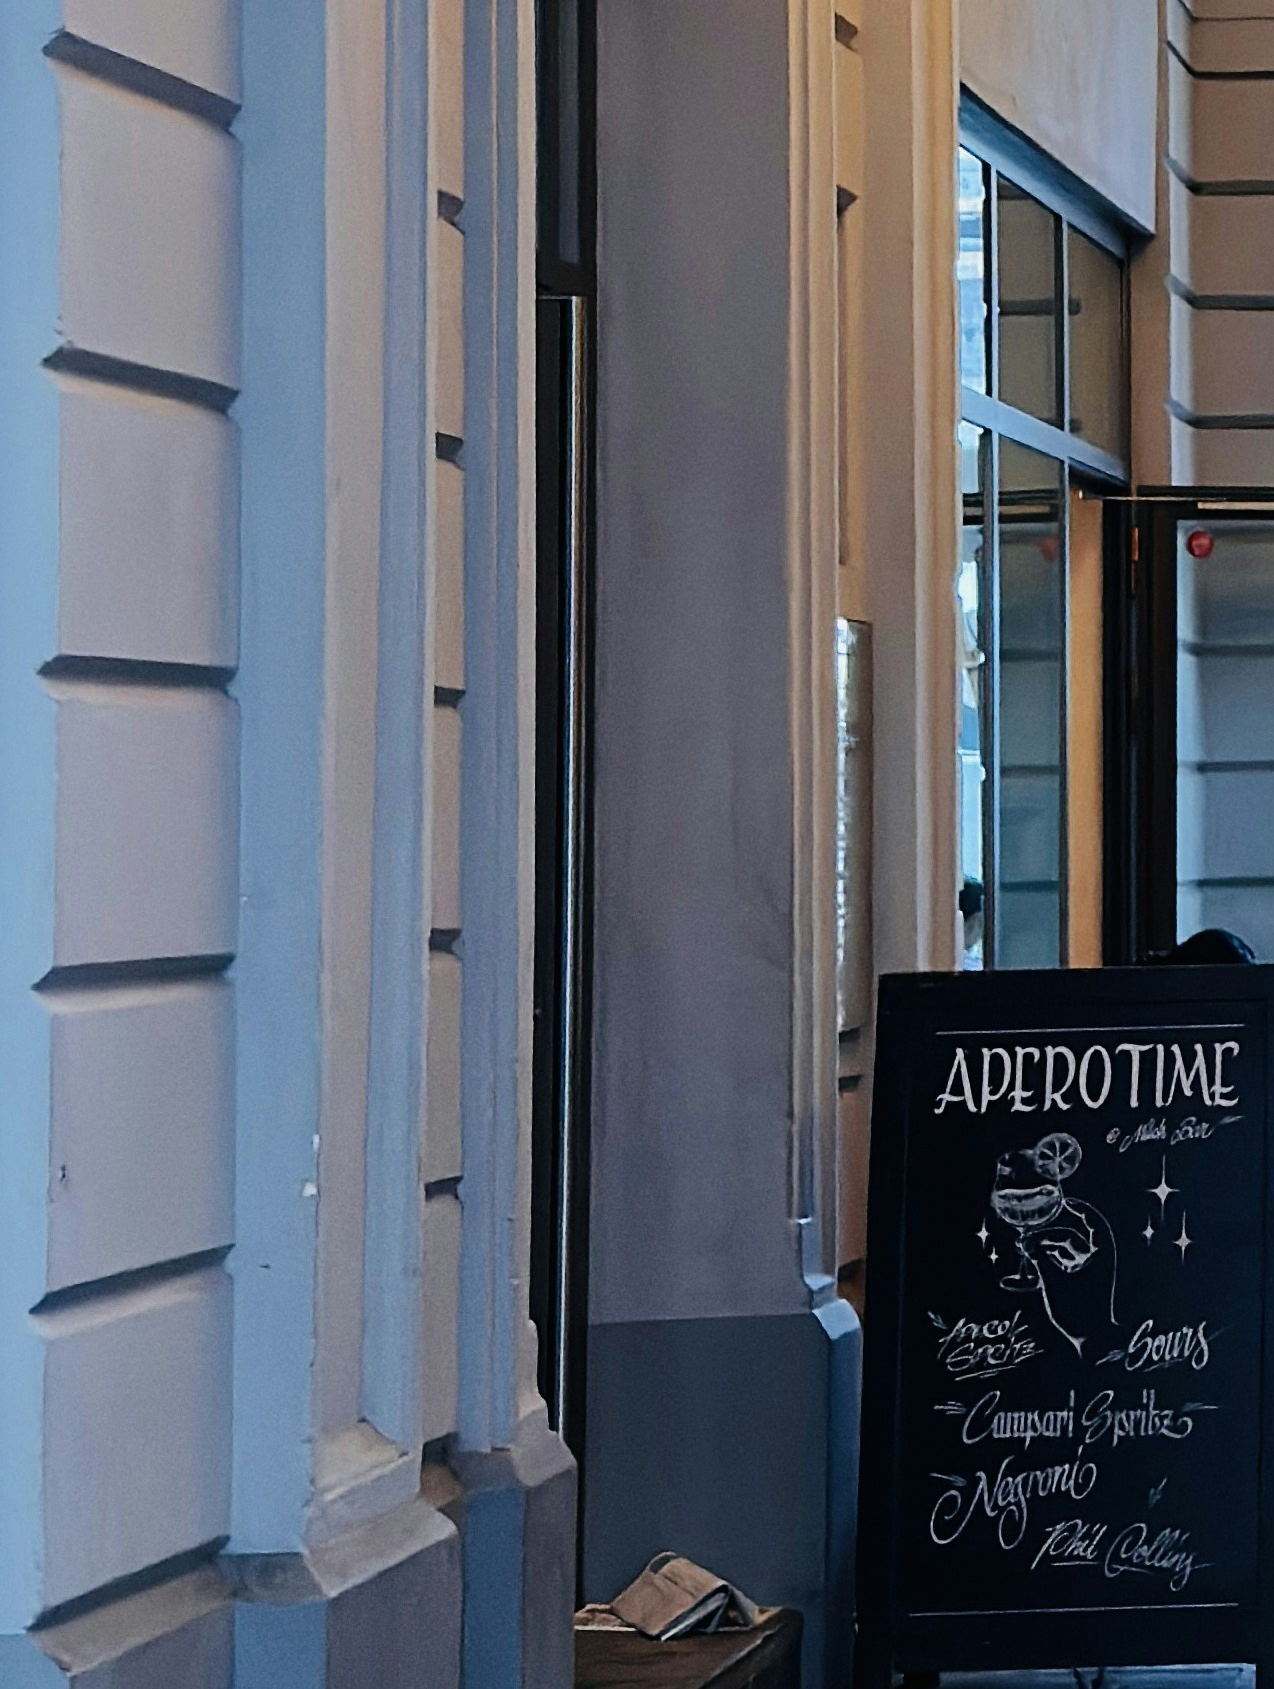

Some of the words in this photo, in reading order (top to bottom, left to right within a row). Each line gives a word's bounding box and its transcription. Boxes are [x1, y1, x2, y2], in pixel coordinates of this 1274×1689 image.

[934, 1041, 1240, 1114] APEROTIME
[1125, 1319, 1209, 1371] Sours
[962, 1389, 1075, 1451] Campari
[1081, 1389, 1193, 1448] Spritz
[930, 1444, 1097, 1550] Negroni
[1030, 1518, 1108, 1571] Phil
